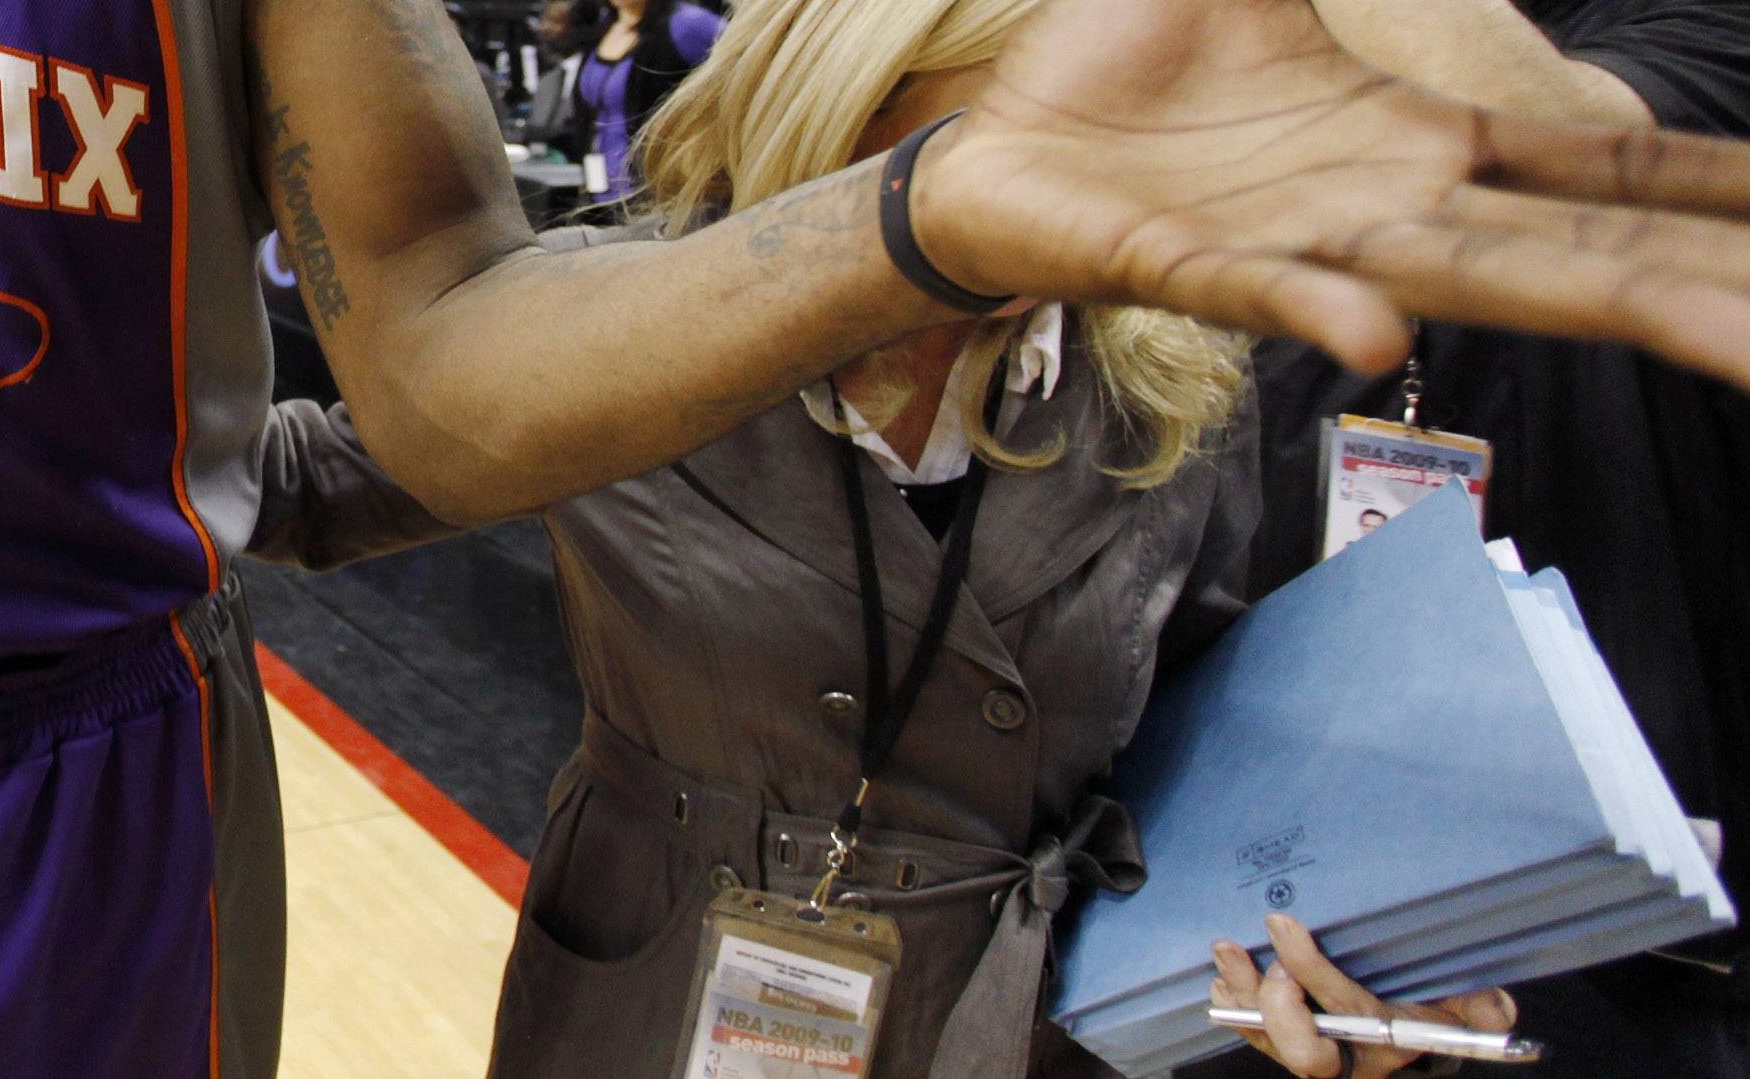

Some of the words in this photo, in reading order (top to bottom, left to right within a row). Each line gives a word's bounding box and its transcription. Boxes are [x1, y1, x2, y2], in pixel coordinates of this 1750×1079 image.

[717, 1006, 764, 1033] NBA
[769, 1020, 854, 1052] 2009-10
[730, 1034, 800, 1059] season
[803, 1047, 851, 1064] pass
